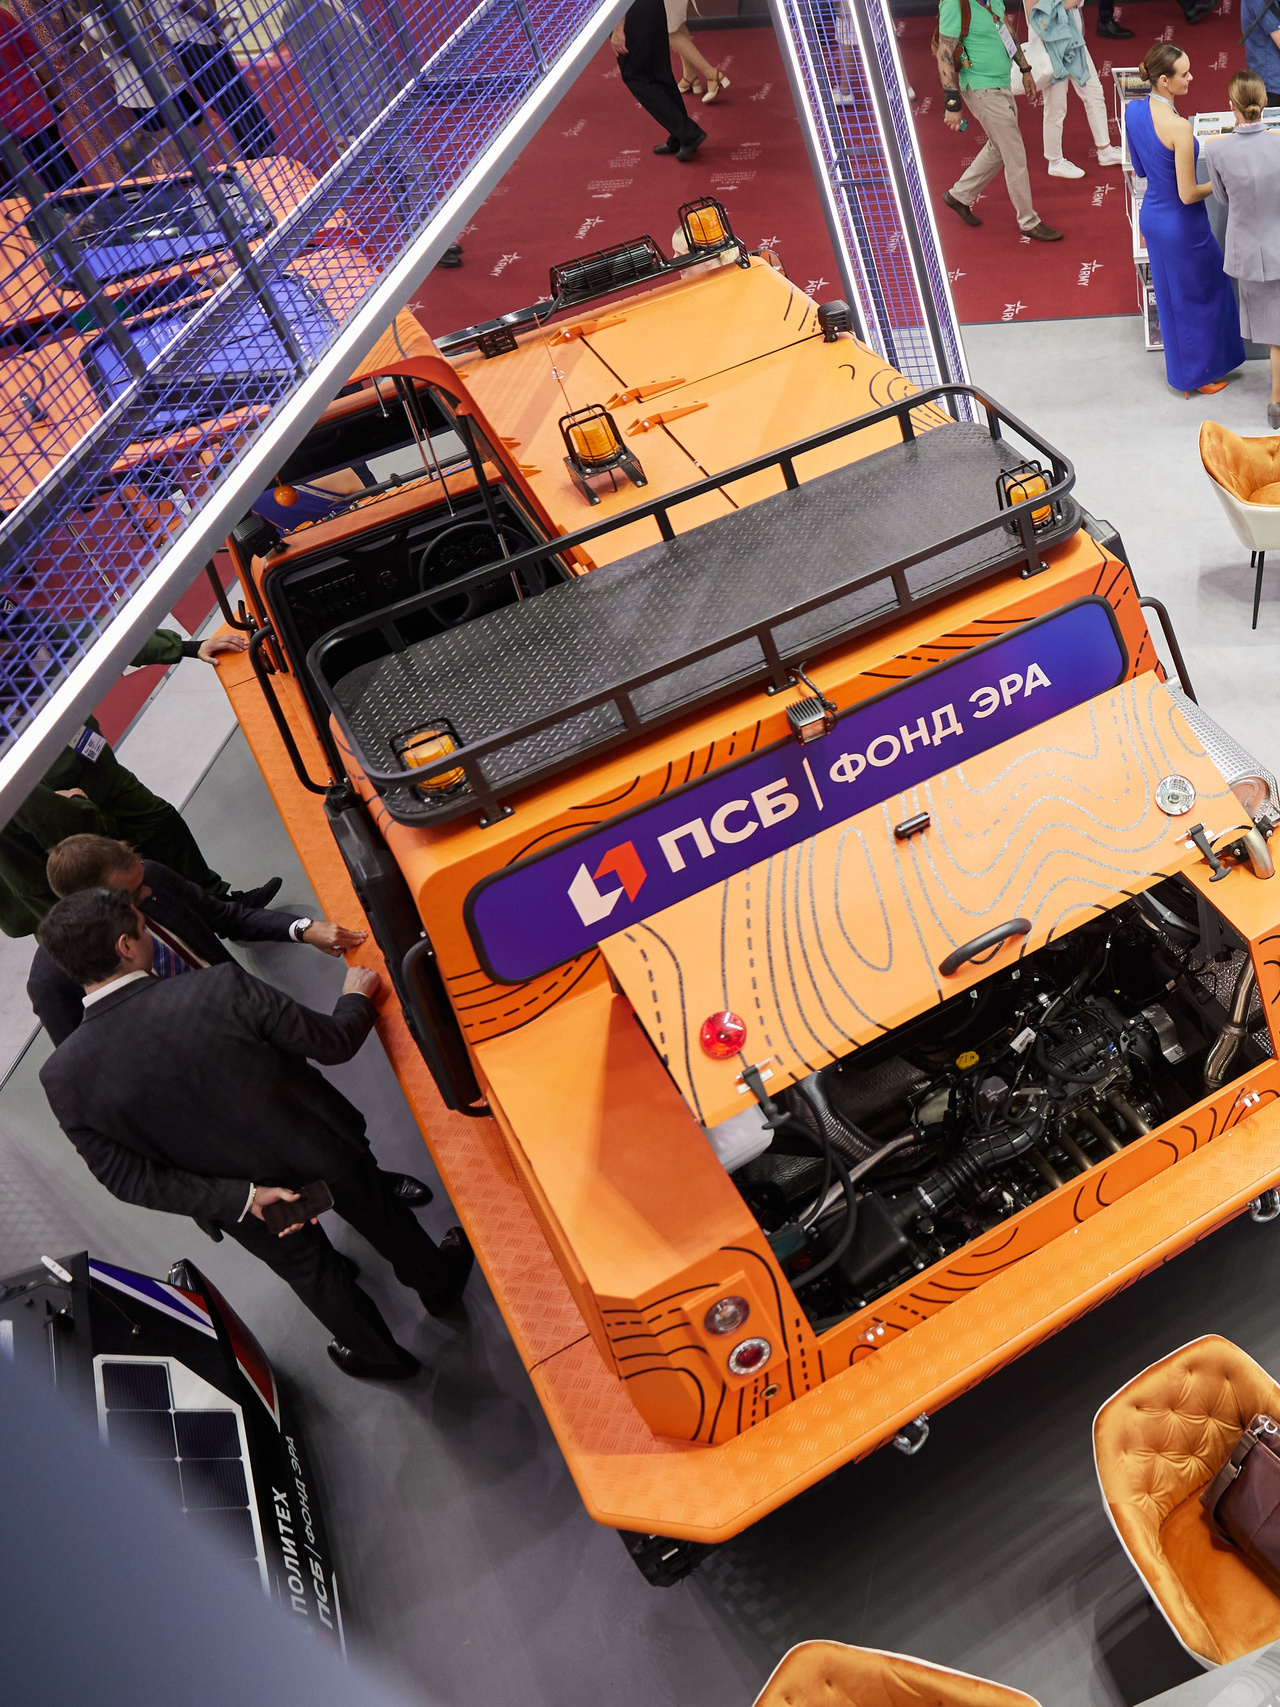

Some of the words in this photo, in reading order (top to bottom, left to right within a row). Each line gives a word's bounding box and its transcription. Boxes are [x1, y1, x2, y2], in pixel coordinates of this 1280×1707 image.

[658, 777, 799, 873] ПСБ
[829, 703, 965, 783] ФОНД
[968, 663, 1052, 719] ЭРА
[285, 1435, 302, 1475] ЭРА
[295, 1477, 316, 1545] ФОНД
[271, 1486, 308, 1615] ПОЛИТЕХ
[309, 1557, 334, 1629] ПСБ
